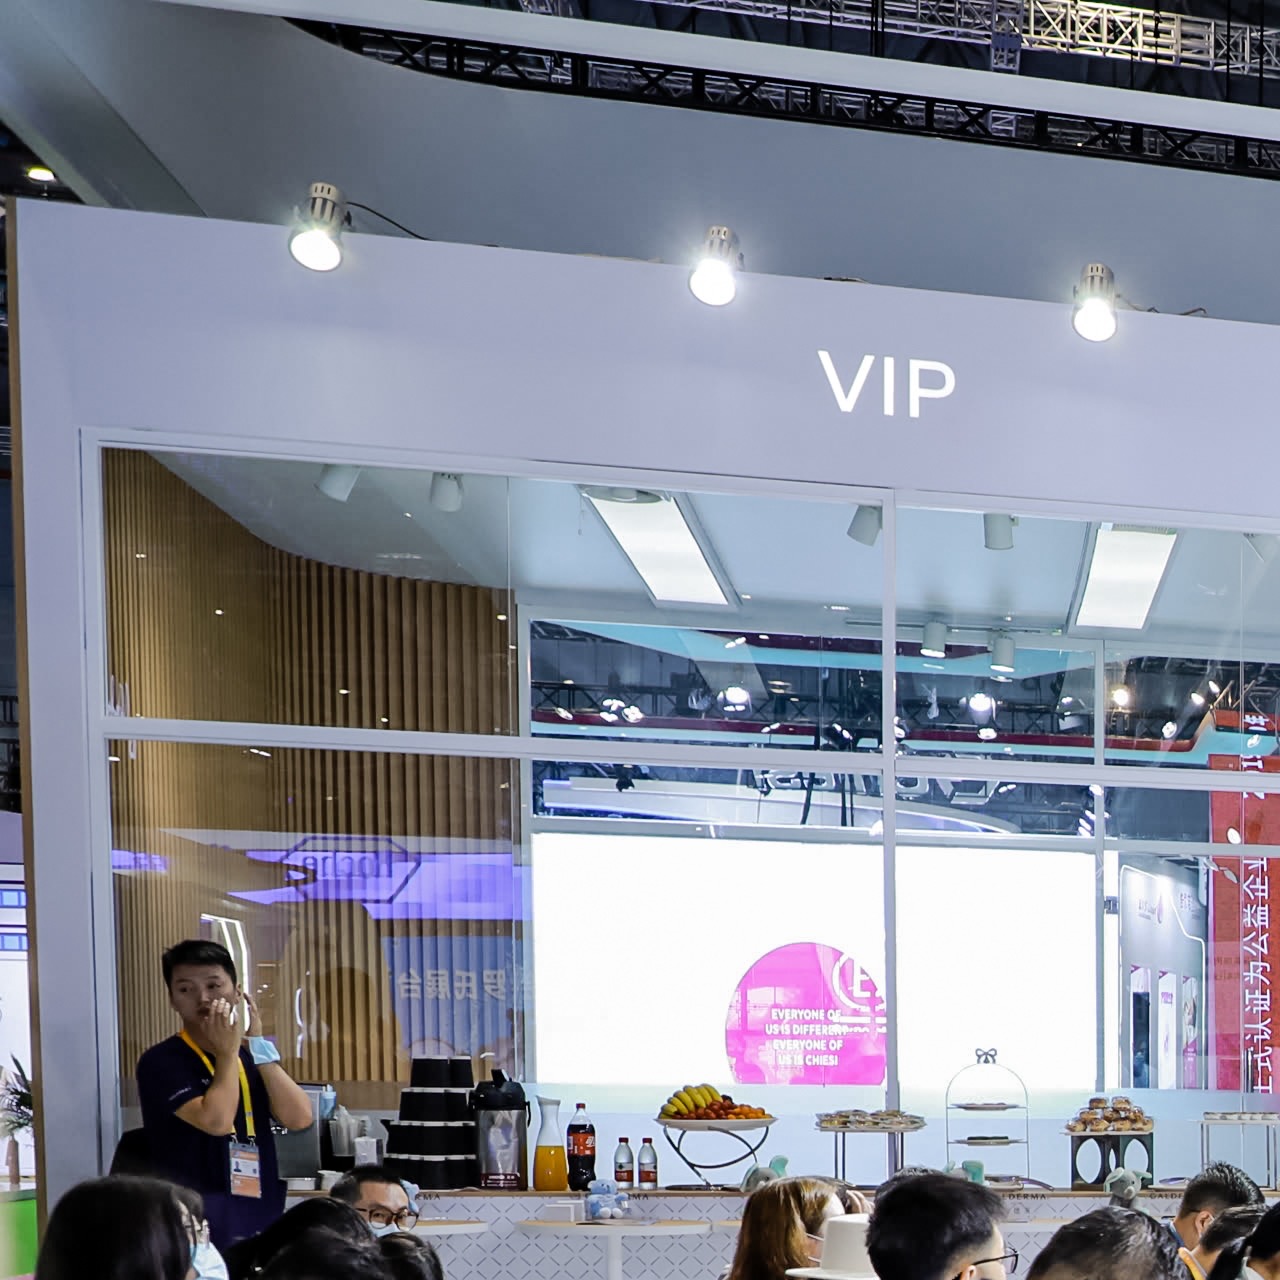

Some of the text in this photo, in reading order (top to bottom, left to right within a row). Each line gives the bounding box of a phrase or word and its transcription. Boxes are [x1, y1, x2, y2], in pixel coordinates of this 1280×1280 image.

[817, 350, 956, 418] VIP
[771, 1008, 842, 1020] EVERYONE OF
[765, 1023, 779, 1035] US
[773, 1039, 843, 1051] EVERYONE OF
[778, 1054, 792, 1065] US
[805, 1055, 839, 1066] CHIESI
